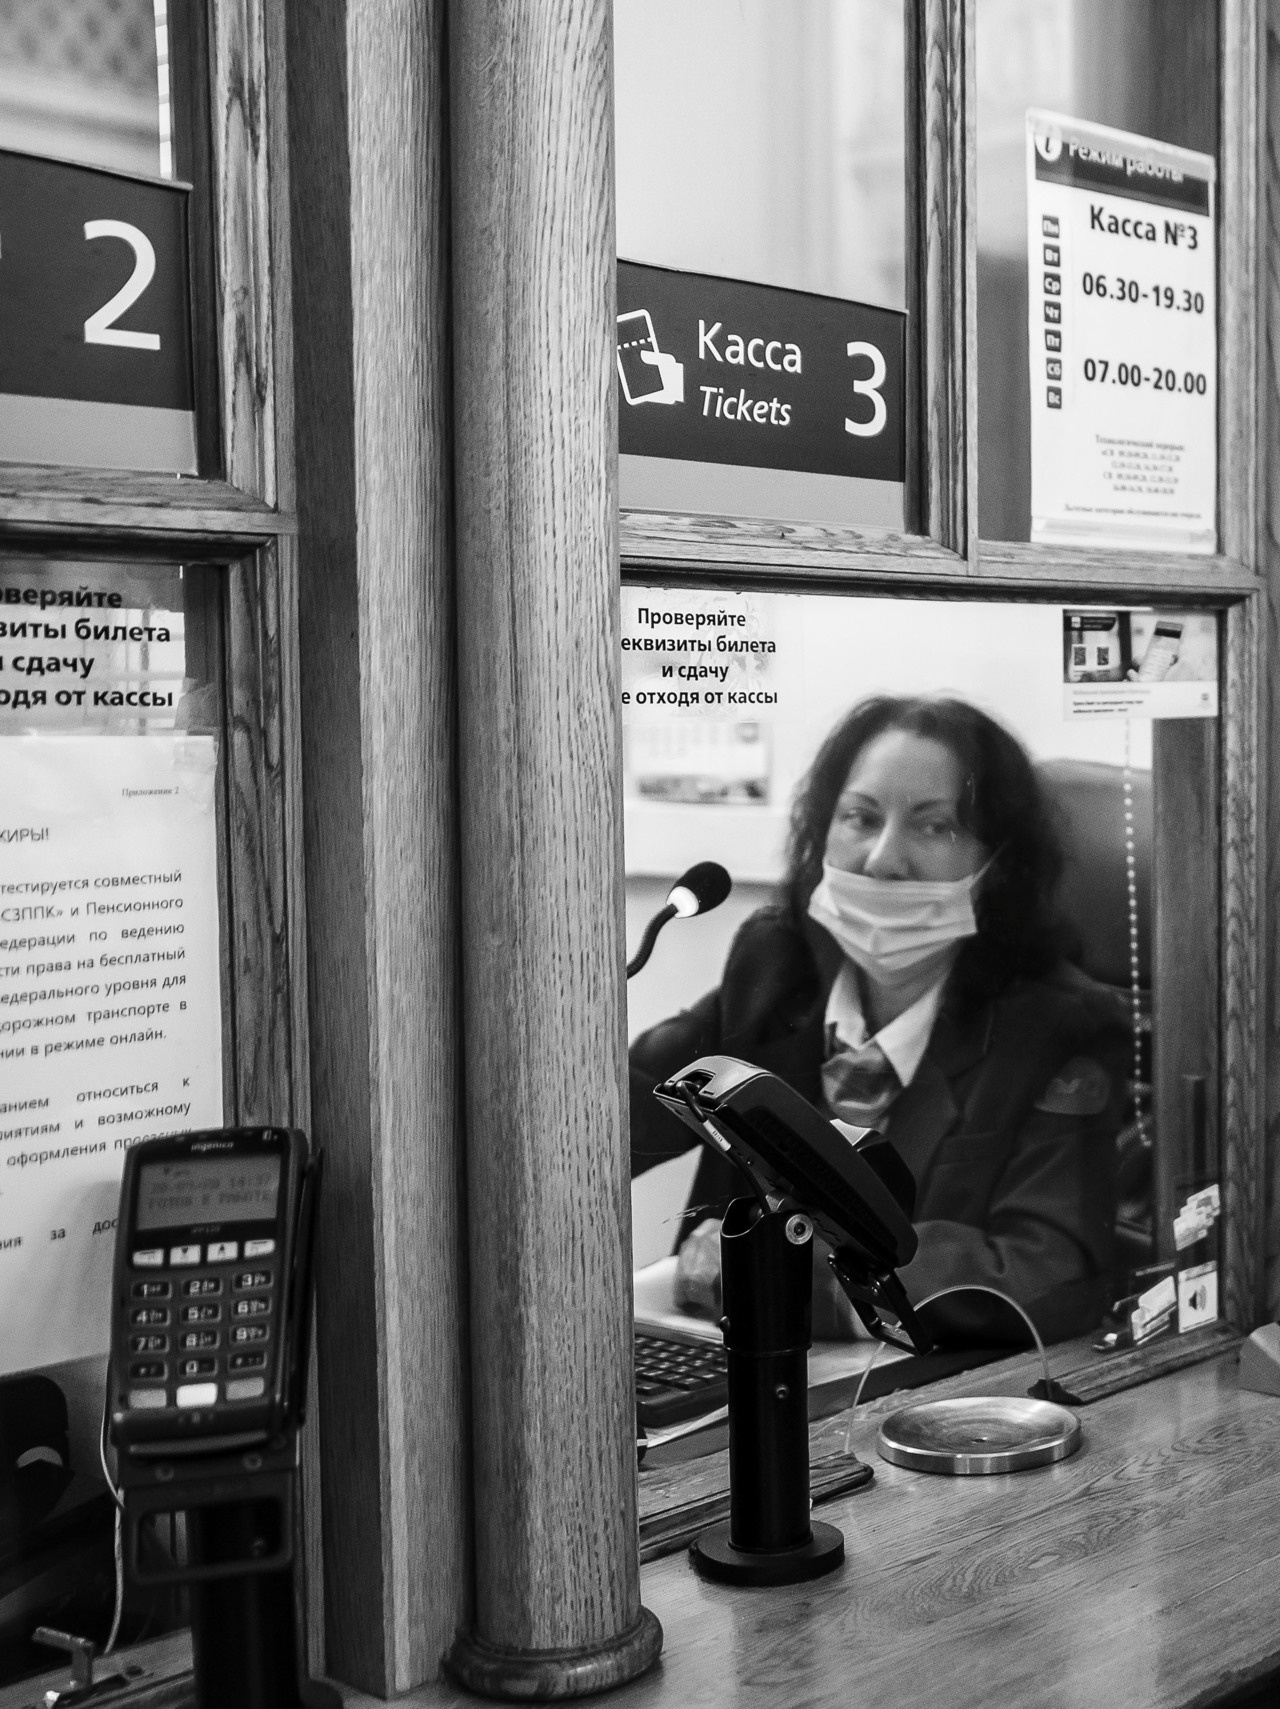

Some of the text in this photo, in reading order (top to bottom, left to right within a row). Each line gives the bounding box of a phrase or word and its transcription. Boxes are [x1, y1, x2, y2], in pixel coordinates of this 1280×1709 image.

[1090, 204, 1156, 242] Касса
[84, 219, 160, 350] 2
[1082, 272, 1205, 314] 06.30-19.30
[698, 319, 802, 374] Касса
[845, 341, 887, 437] 3
[1084, 358, 1207, 395] 07.00-20.00
[700, 385, 791, 426] Tickets
[0, 586, 123, 610] веряйте
[74, 618, 171, 642] билета
[637, 607, 746, 629] Проверяйте
[716, 635, 776, 653] билета
[12, 655, 95, 678] сдачу
[661, 664, 729, 682] и сдачу
[55, 690, 86, 706] от
[93, 689, 173, 707] кассы
[635, 691, 699, 707] отходя
[704, 691, 724, 704] от
[728, 691, 778, 704] кассы
[122, 786, 180, 797] Приложение 2
[1, 869, 182, 895] тестируется совместный
[70, 906, 79, 917] и
[86, 897, 183, 916] Пенсионного
[0, 923, 185, 951] едерации по ведению
[26, 961, 72, 977] права
[77, 958, 94, 970] на
[99, 946, 186, 967] бесплатный
[0, 974, 186, 1006] едерального уровня для
[87, 1001, 170, 1024] транспорте
[179, 1000, 187, 1011] в
[31, 1044, 39, 1055] в
[44, 1036, 105, 1056] режиме
[109, 1027, 167, 1046] онлайн.
[76, 1081, 159, 1103] относиться
[182, 1076, 190, 1088] к
[75, 1119, 84, 1130] и
[98, 1102, 191, 1125] возможному
[7, 1141, 107, 1168] оформления
[50, 1228, 66, 1240] за
